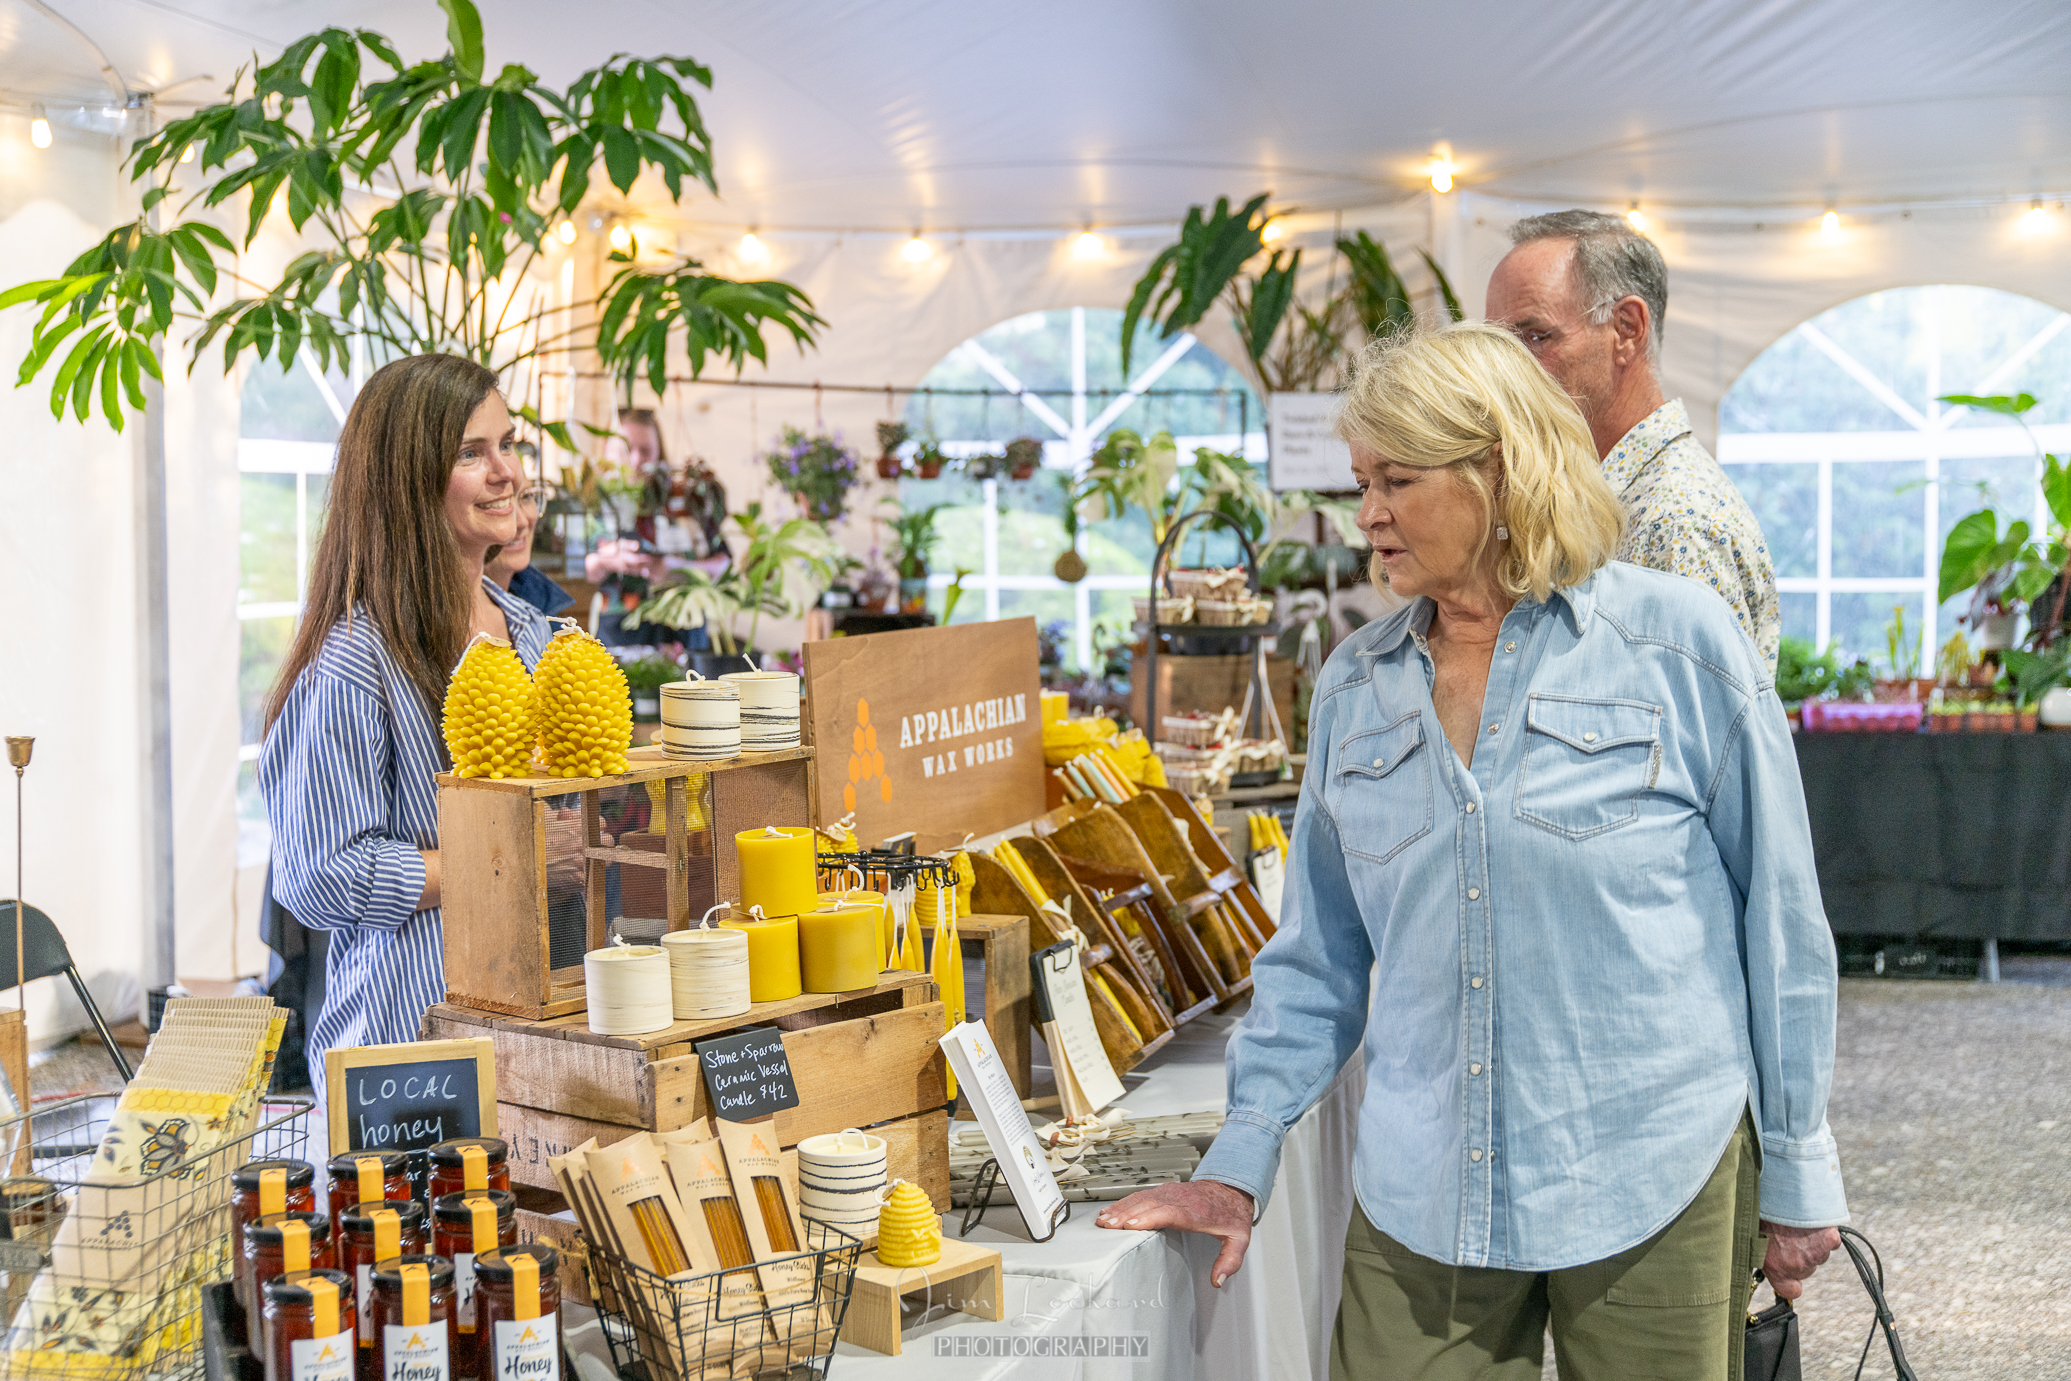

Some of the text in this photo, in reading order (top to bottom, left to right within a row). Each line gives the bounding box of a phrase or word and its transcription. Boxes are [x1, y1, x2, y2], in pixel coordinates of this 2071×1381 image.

[900, 694, 1026, 749] APPALACHIAN
[922, 737, 1014, 778] WAX WORKS
[705, 1049, 740, 1068] Stone
[744, 1043, 785, 1062] Sparrow
[359, 1074, 458, 1106] LOCAL
[715, 1060, 788, 1091] Ceramic Vessel
[720, 1081, 788, 1110] Candle $42
[359, 1114, 443, 1149] honey
[391, 1361, 442, 1381] Honey
[504, 1355, 553, 1380] Honey
